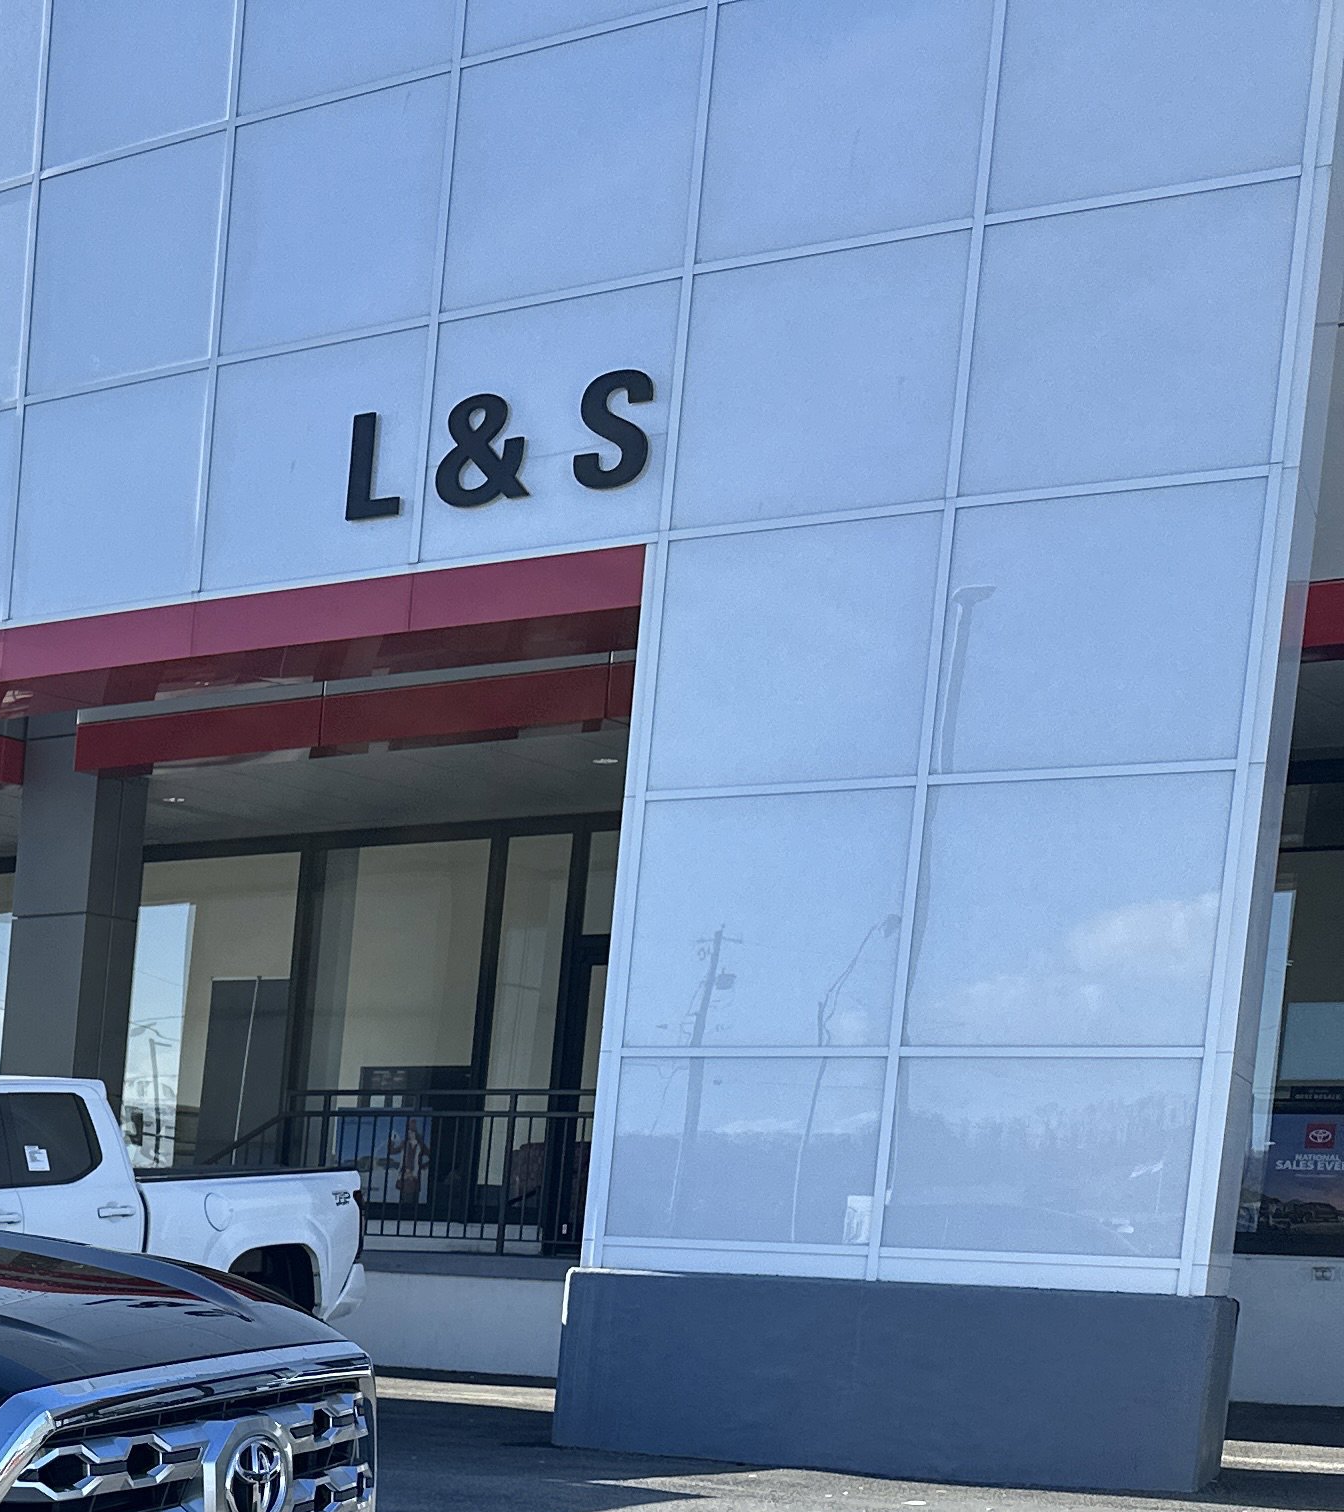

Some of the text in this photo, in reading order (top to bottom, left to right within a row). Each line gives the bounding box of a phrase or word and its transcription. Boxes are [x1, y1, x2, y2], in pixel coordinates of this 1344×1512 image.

[346, 369, 654, 521] L & S
[1276, 1161, 1314, 1170] SALES
